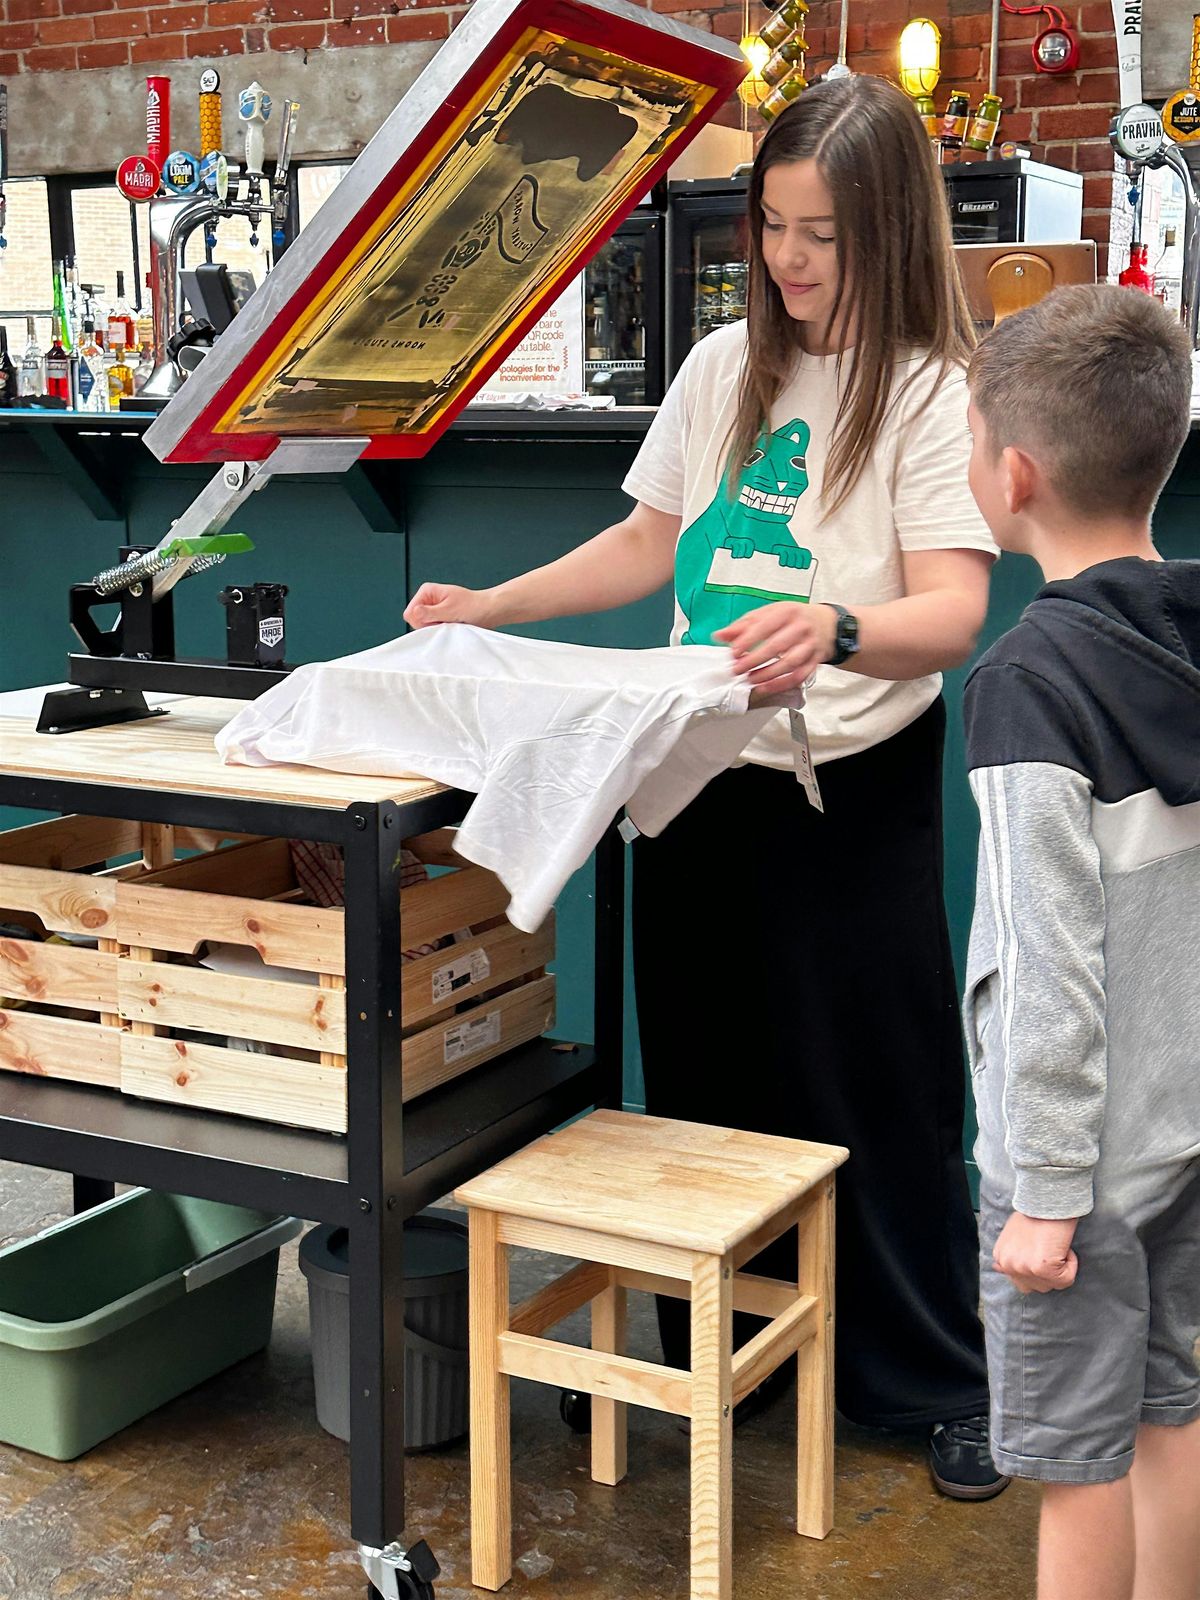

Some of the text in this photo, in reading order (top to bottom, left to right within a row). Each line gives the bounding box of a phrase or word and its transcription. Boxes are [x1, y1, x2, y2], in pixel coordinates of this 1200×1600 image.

[1180, 107, 1198, 116] JUTE
[1122, 122, 1162, 139] PRAVHA
[173, 175, 189, 184] PALE
[542, 330, 564, 340] code
[530, 341, 552, 351] table.
[535, 364, 545, 372] for
[548, 364, 560, 372] the
[500, 374, 556, 382] inconvenience.
[261, 628, 281, 638] MADE
